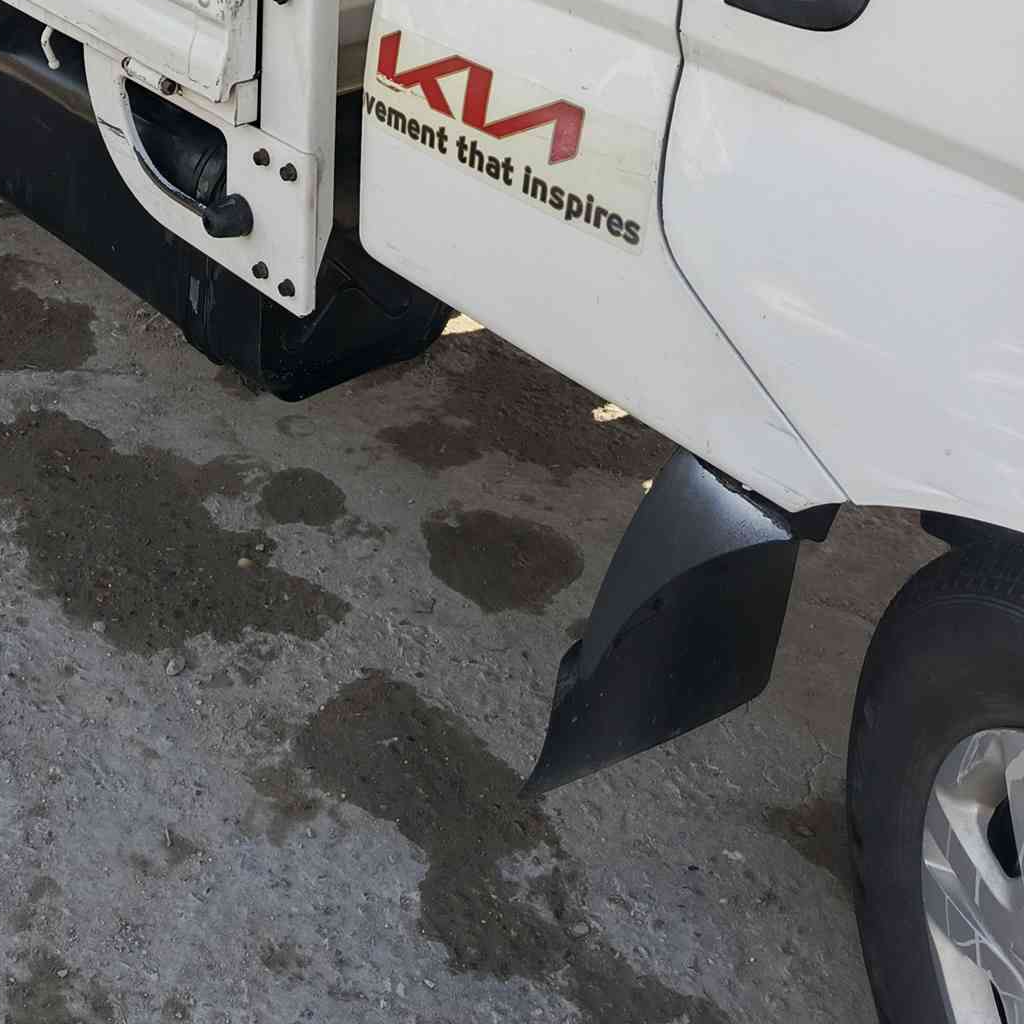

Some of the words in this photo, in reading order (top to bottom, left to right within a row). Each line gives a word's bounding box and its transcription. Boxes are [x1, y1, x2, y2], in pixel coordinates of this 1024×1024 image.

[377, 30, 586, 165] KIA
[455, 135, 514, 186] that
[522, 165, 641, 246] inspires
